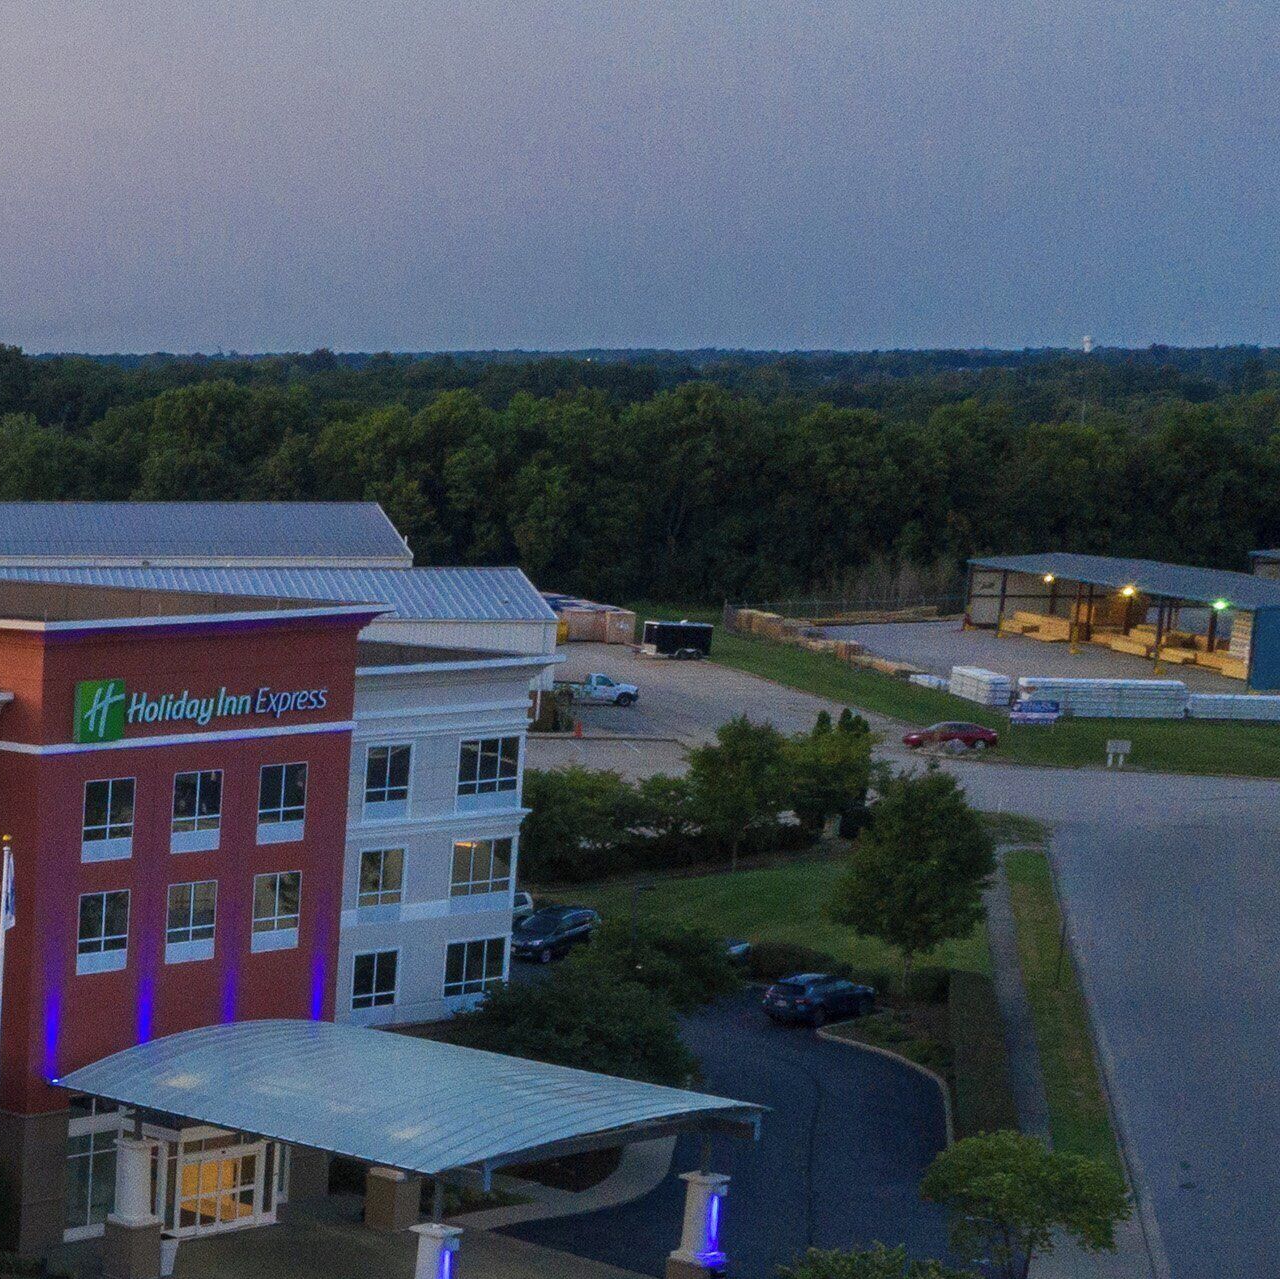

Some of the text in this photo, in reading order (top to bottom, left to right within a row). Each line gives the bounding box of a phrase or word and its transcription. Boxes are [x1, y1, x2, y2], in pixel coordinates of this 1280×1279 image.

[127, 686, 328, 725] Holiday Inn Express
